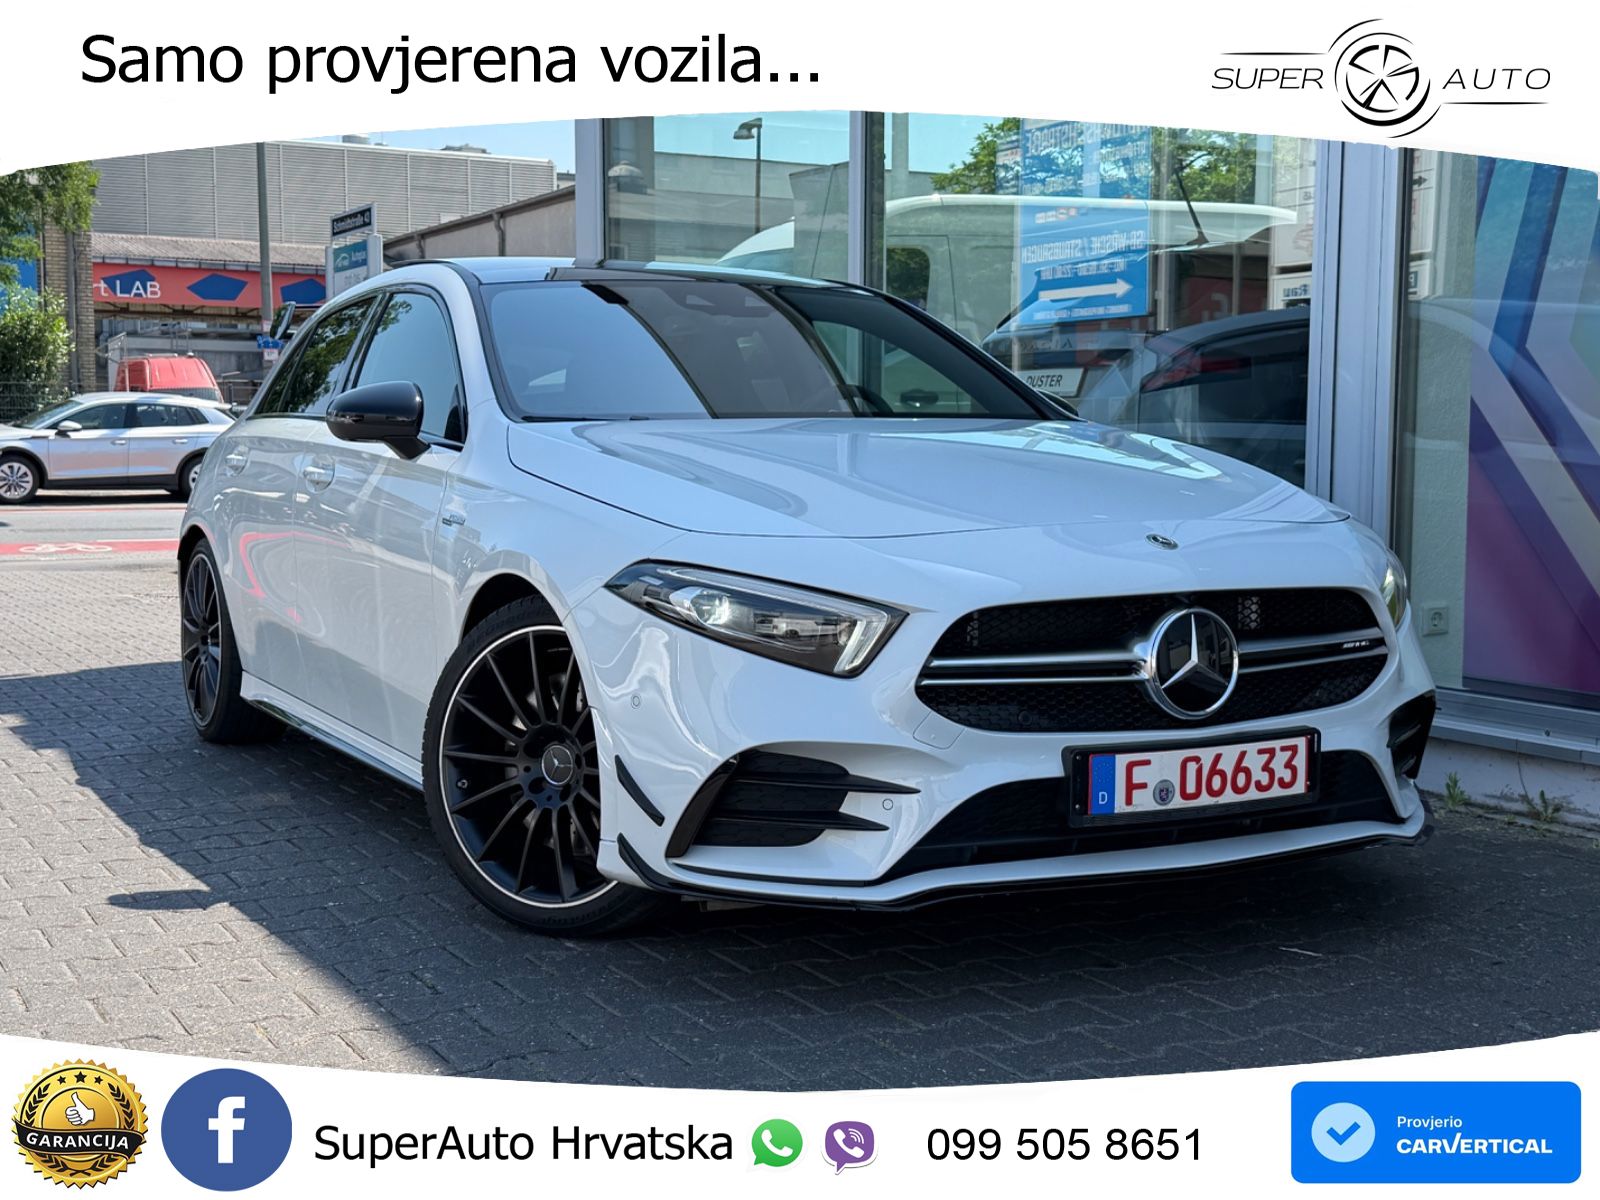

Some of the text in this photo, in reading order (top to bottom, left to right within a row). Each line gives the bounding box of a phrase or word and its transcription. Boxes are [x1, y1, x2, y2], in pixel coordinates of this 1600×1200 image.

[115, 279, 161, 298] LAB
[1125, 744, 1298, 806] F 06633
[1098, 791, 1108, 805] D
